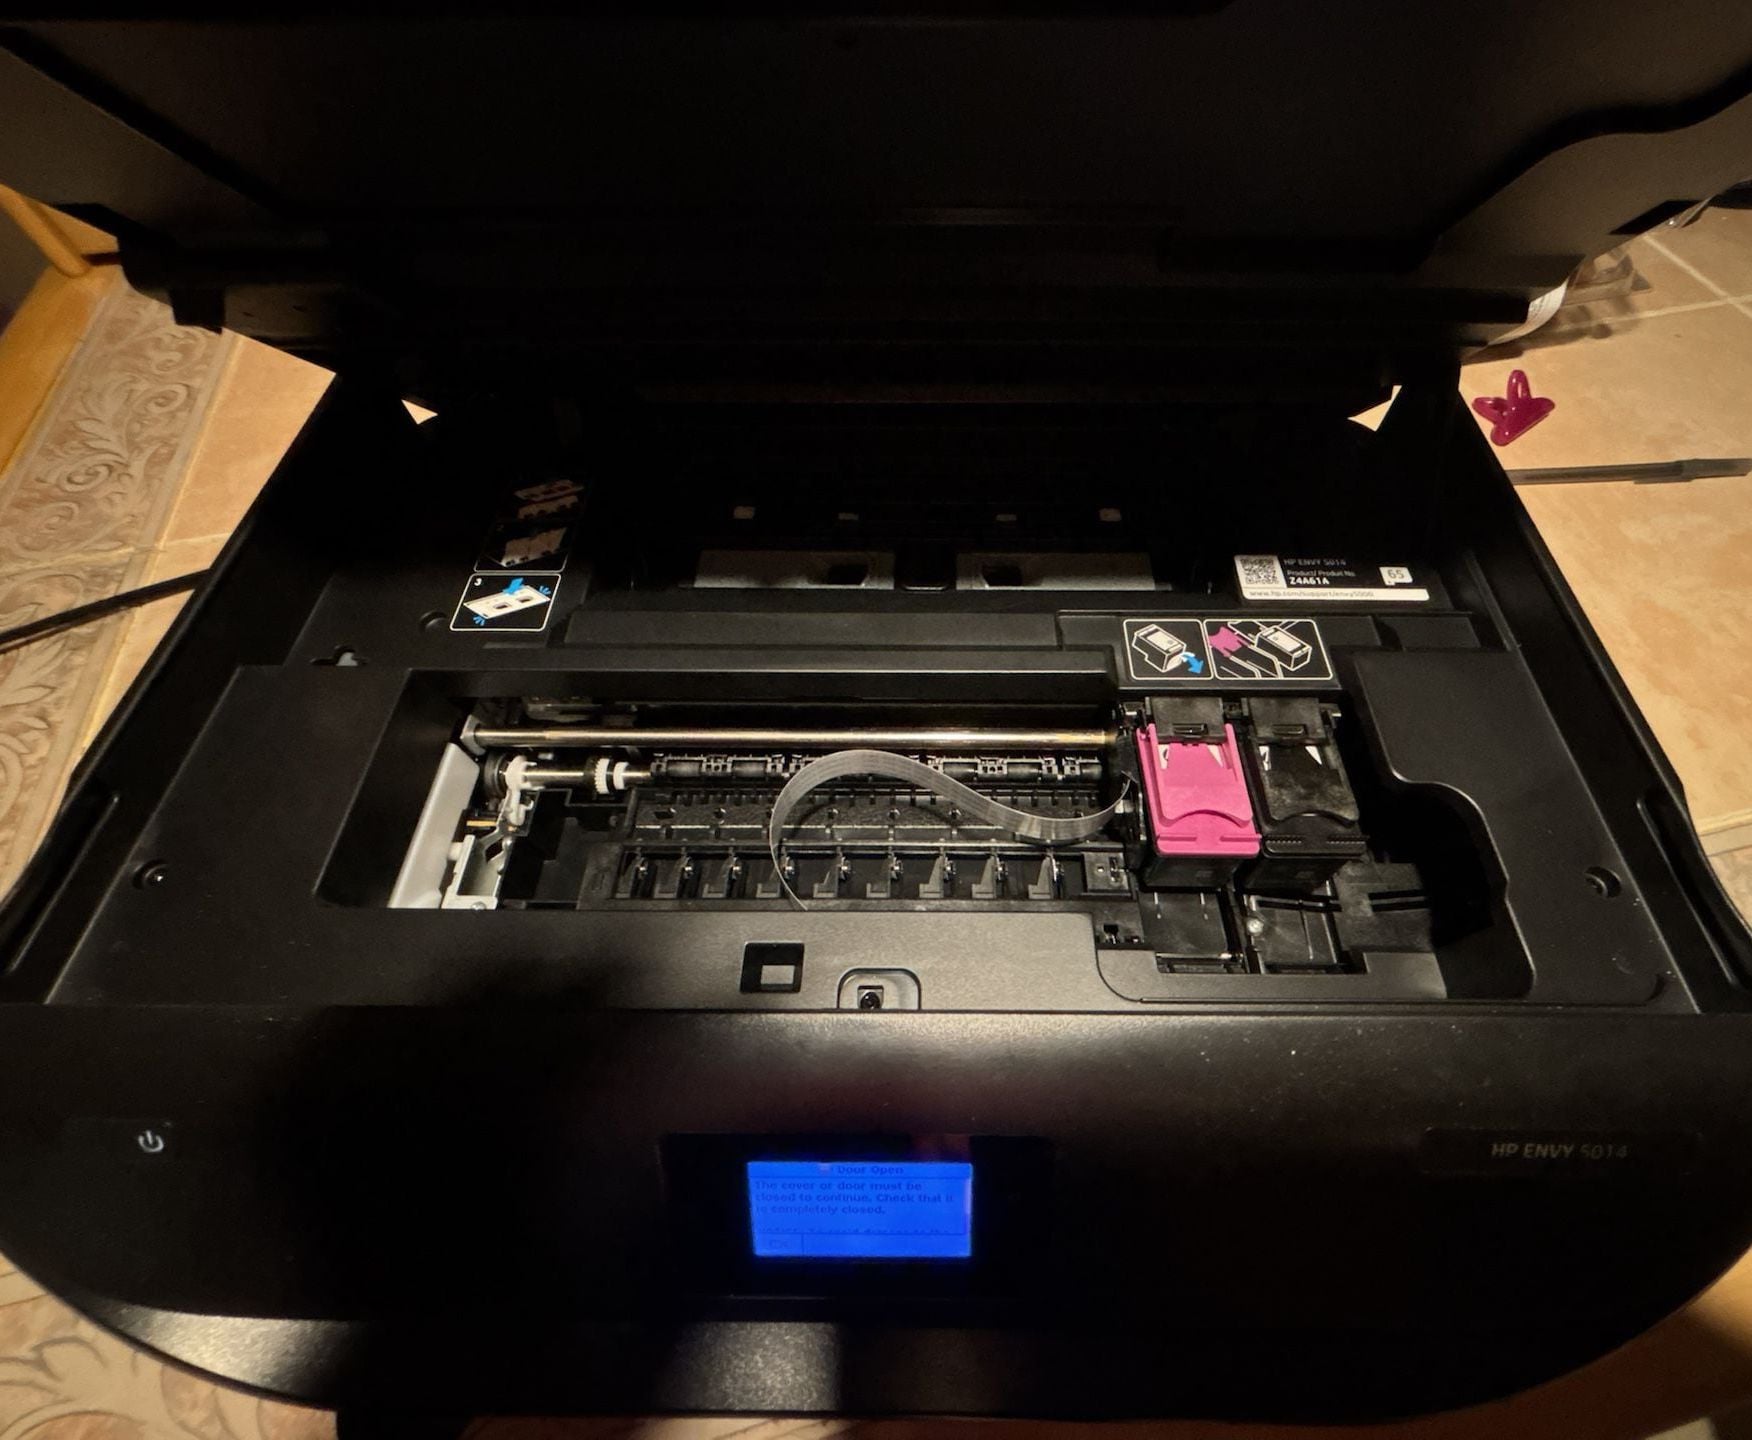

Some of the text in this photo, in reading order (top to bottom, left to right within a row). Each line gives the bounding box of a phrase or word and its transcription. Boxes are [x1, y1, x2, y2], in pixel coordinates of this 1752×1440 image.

[1387, 569, 1405, 579] 65
[474, 578, 482, 586] 3
[1289, 576, 1330, 585] Z4A61A
[1491, 1143, 1629, 1160] HP ENVY 5014
[837, 1165, 905, 1176] Door Open
[756, 1181, 777, 1191] The
[781, 1182, 815, 1191] cover
[837, 1181, 865, 1191] door
[870, 1182, 900, 1191] must
[876, 1193, 914, 1202] Check
